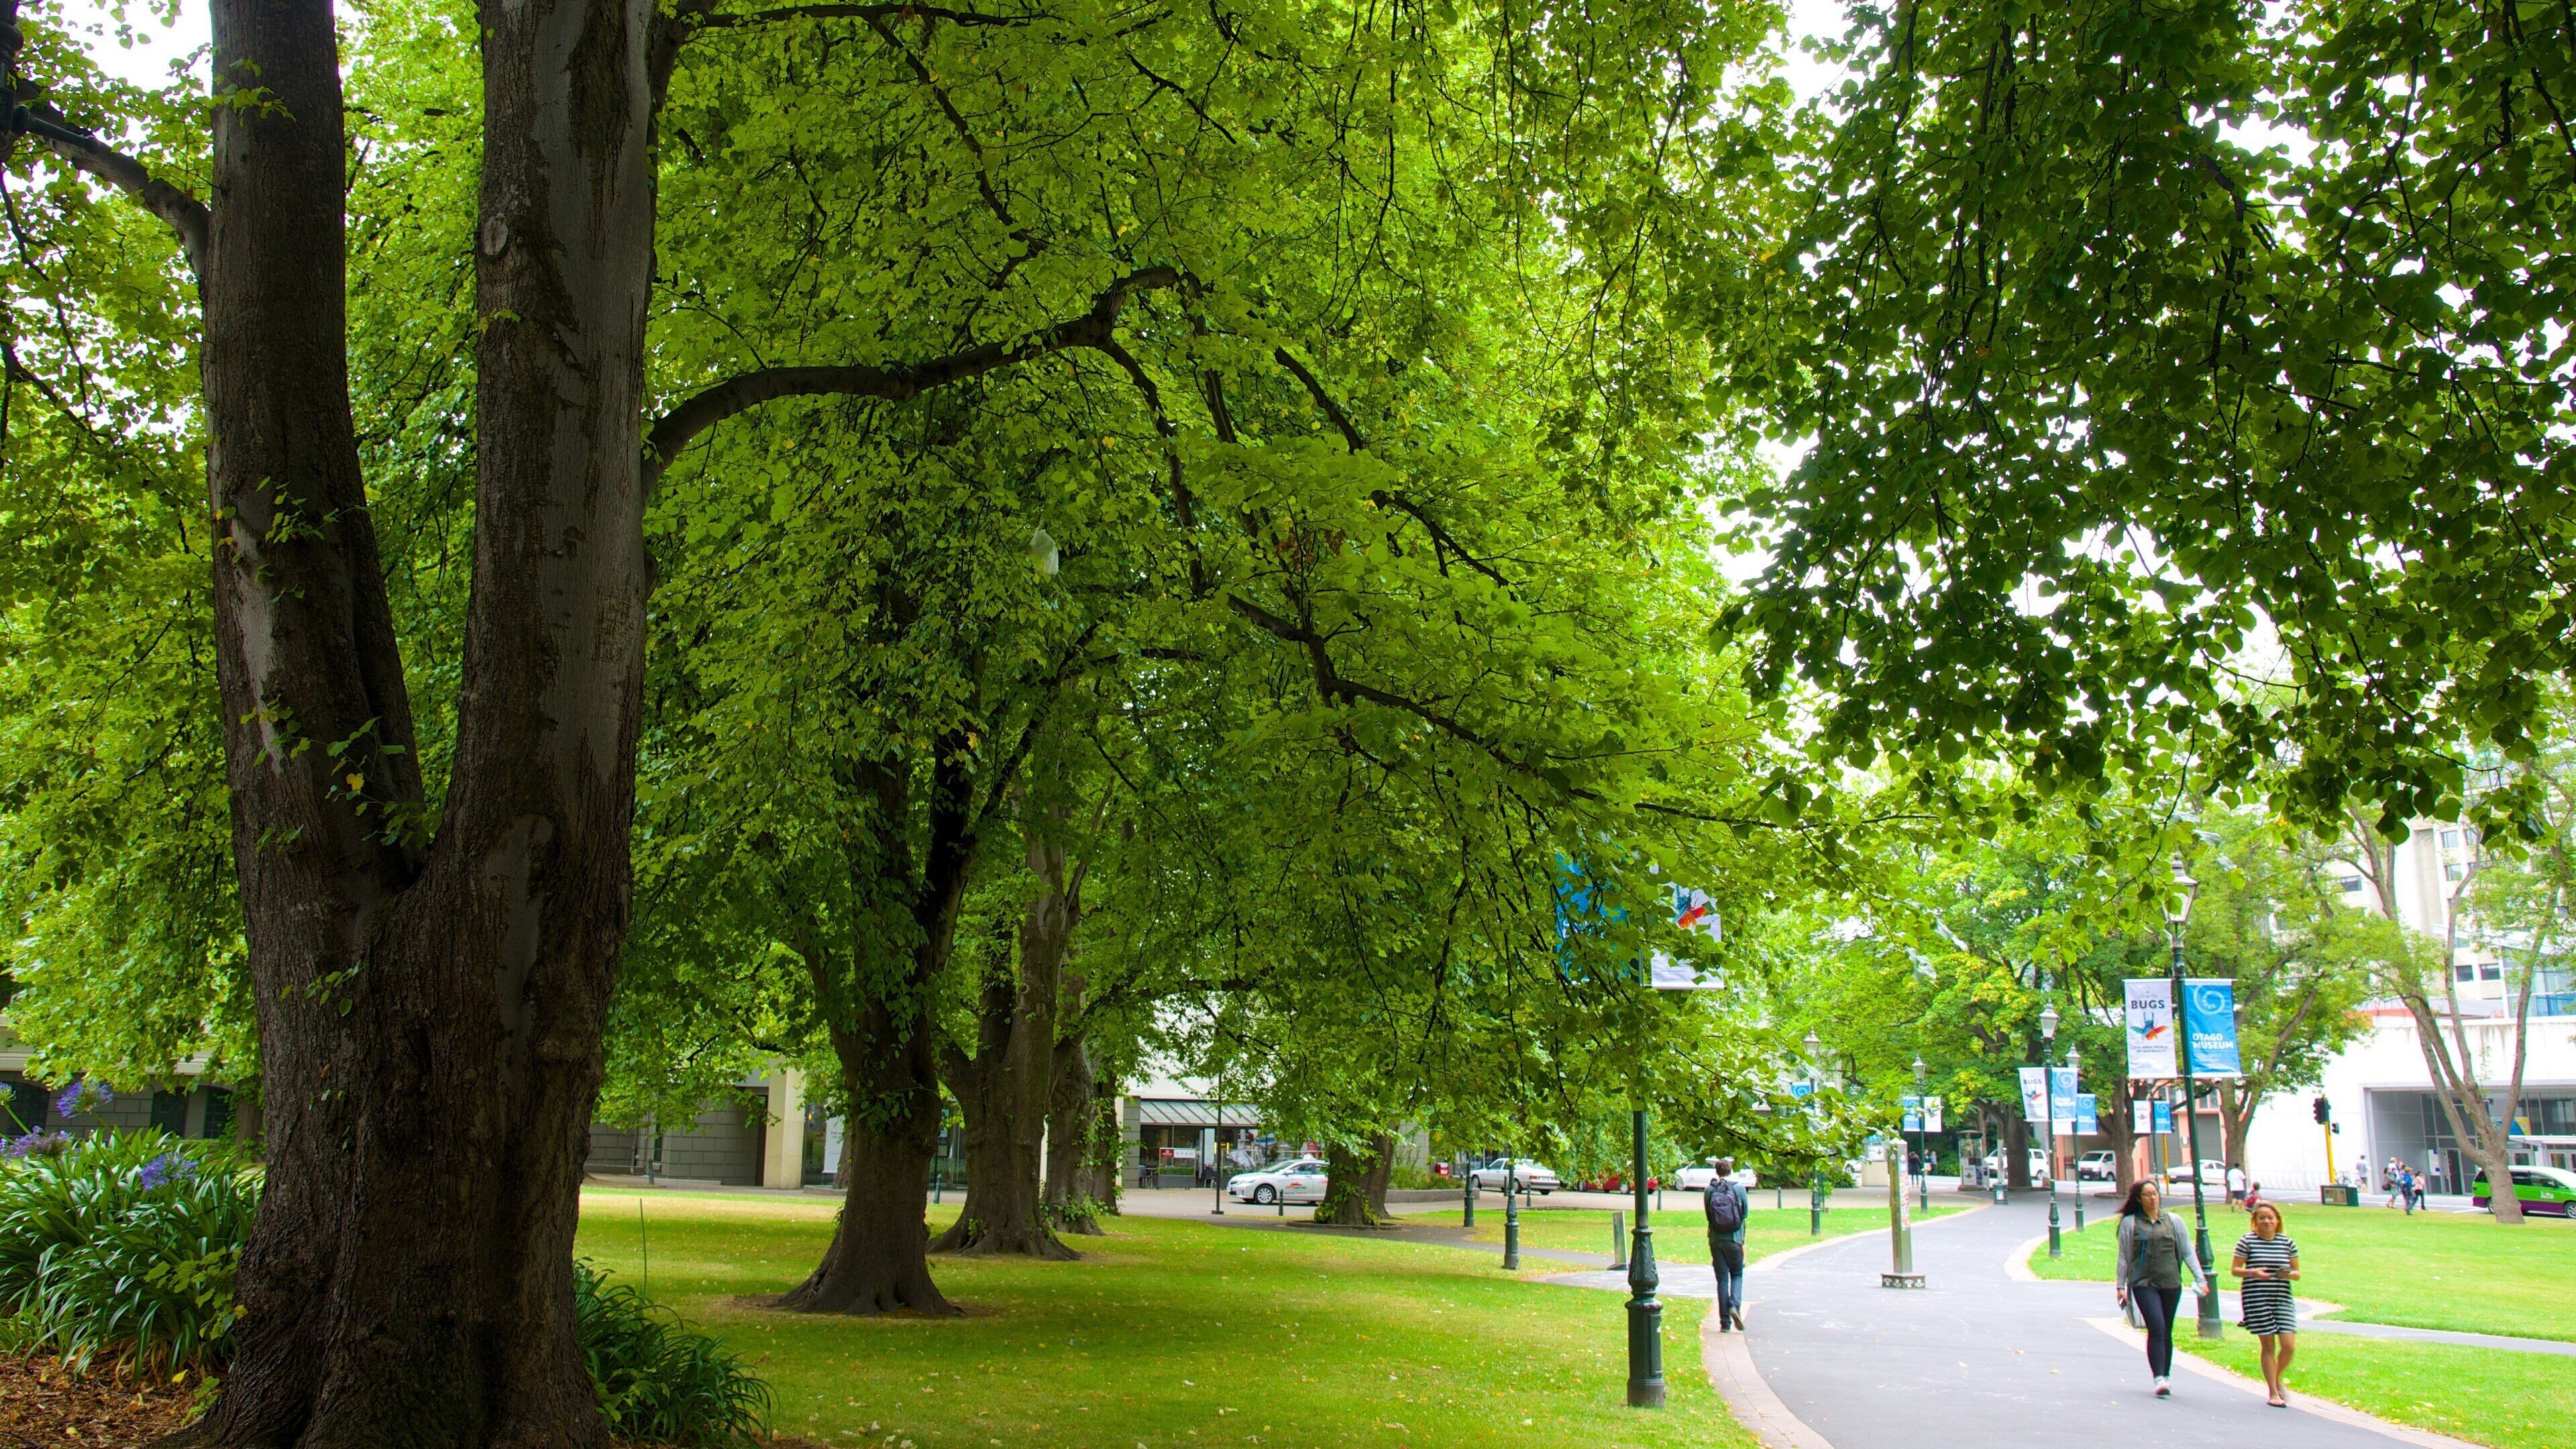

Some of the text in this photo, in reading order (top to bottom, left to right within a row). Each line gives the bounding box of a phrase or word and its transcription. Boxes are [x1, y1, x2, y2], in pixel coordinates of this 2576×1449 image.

[2131, 1000, 2165, 1009] BUGS
[2192, 1032, 2223, 1040] OTAGO
[2192, 1041, 2234, 1049] MUSEUM
